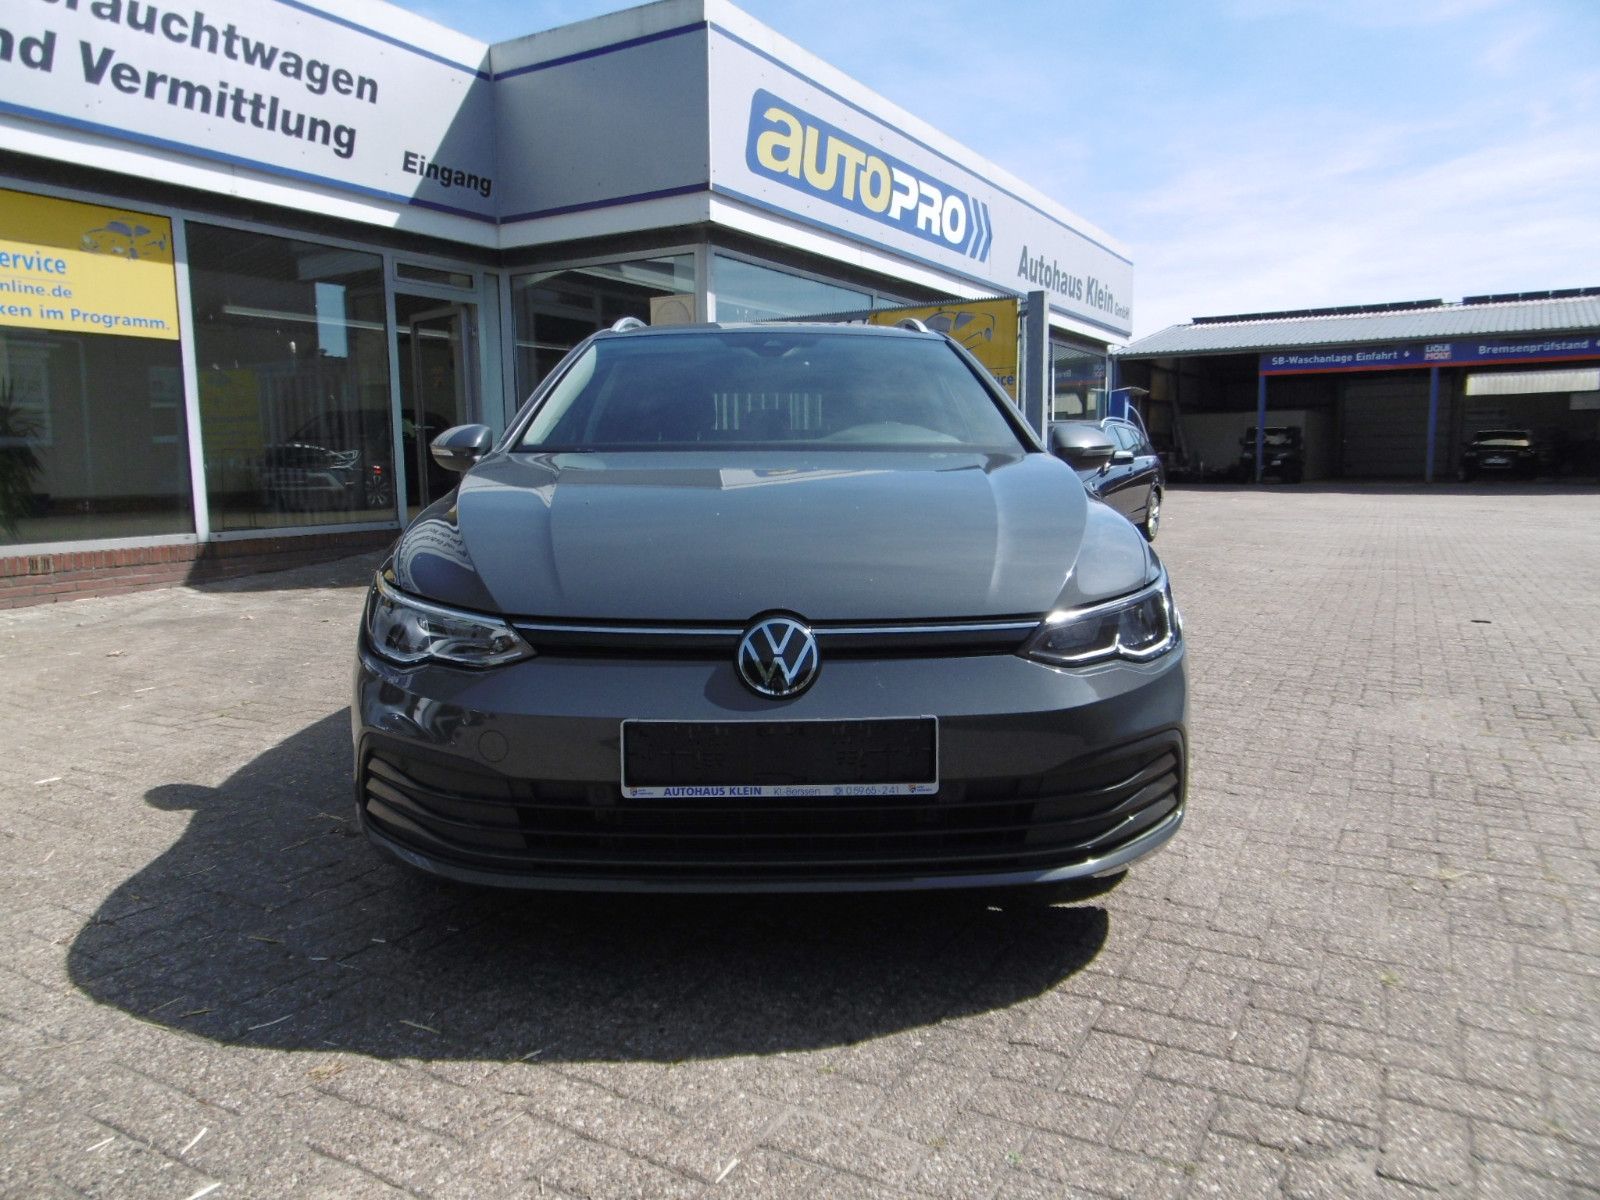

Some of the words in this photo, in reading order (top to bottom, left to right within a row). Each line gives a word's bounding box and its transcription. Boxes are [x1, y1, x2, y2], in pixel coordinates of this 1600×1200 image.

[79, 40, 357, 159] Vermittlung
[402, 151, 493, 197] Eingang
[1017, 245, 1083, 301] Autohaus
[1085, 276, 1113, 314] Klein
[1114, 302, 1130, 320] GmbH
[40, 304, 64, 321] im
[70, 308, 171, 330] Programm.
[1424, 351, 1450, 361] MOLY
[1478, 340, 1589, 355] Bremsenprüfstand
[1271, 353, 1353, 366] SB-Waschanlage
[1356, 351, 1398, 362] Einfahrt
[664, 787, 725, 797] AUTOHAUS
[729, 786, 762, 796] KLEIN
